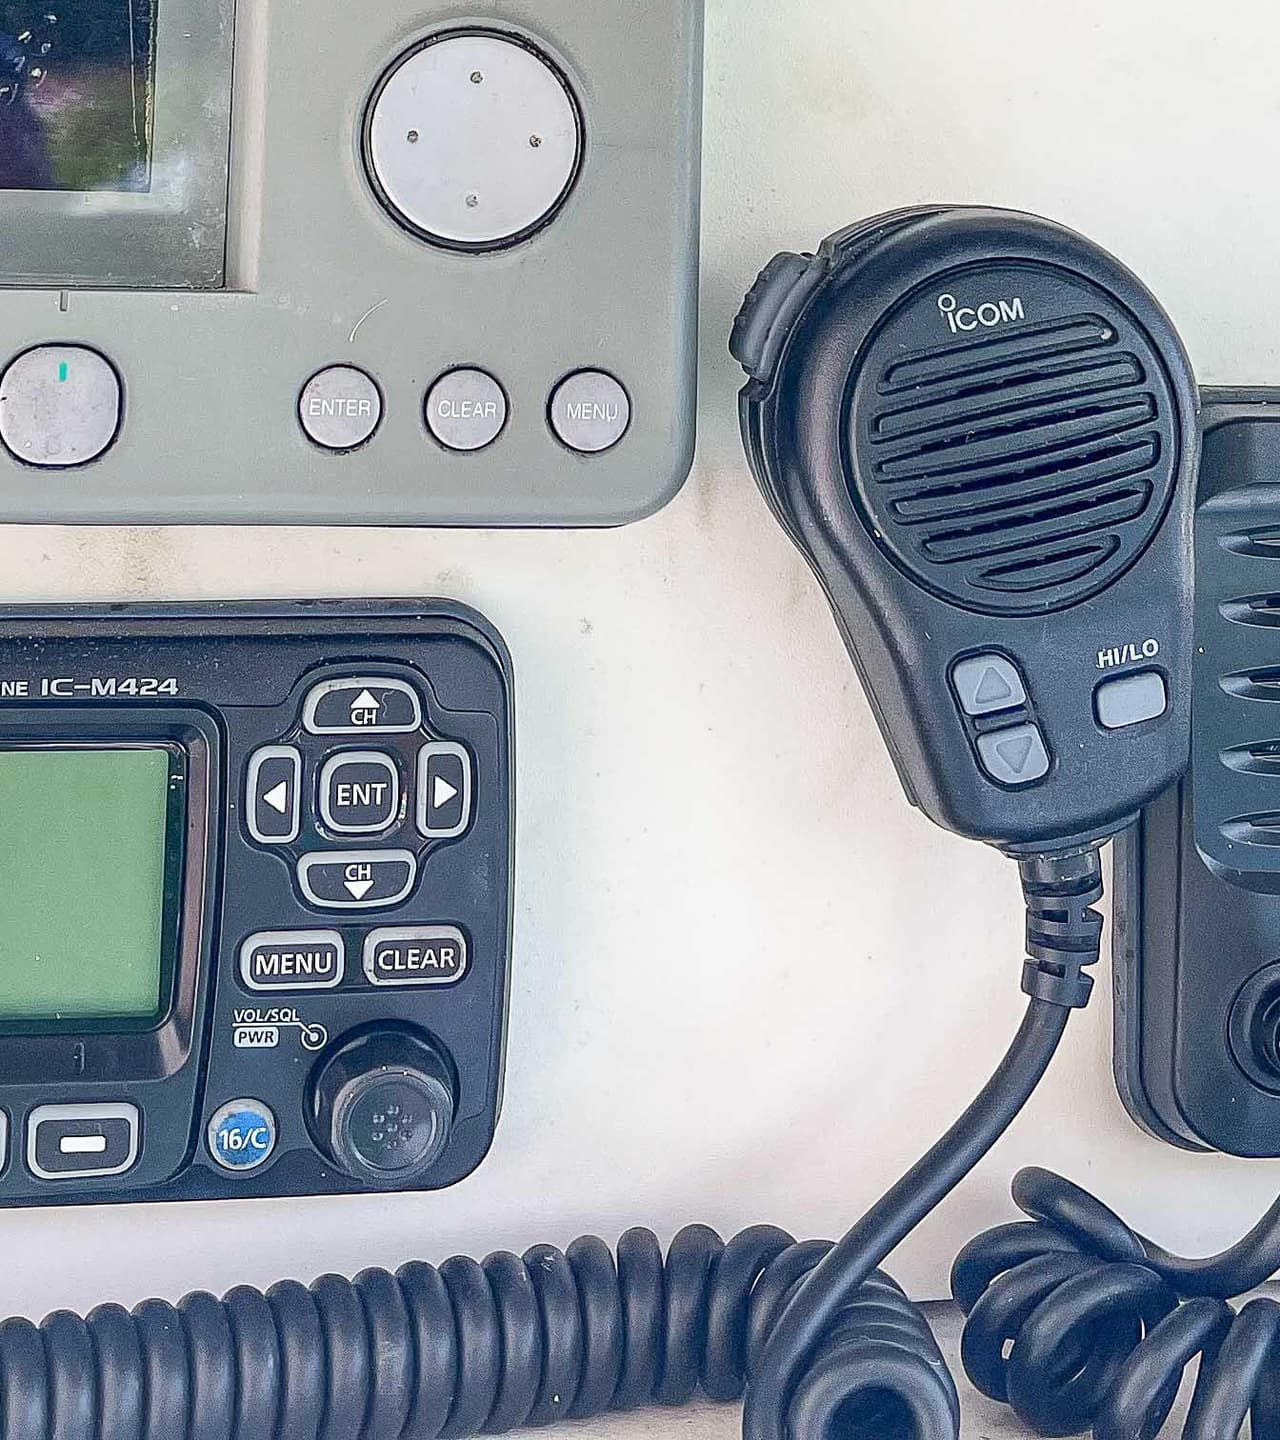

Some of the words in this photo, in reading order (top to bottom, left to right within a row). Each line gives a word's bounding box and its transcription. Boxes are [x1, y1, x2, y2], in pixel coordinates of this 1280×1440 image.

[309, 398, 371, 417] ENTER
[438, 399, 497, 418] CLEAR
[567, 402, 618, 421] MENU
[1096, 638, 1159, 669] HI/LO
[40, 677, 179, 698] IC-M424
[350, 709, 377, 725] CH
[336, 783, 387, 806] ENT
[344, 864, 372, 880] CH
[255, 953, 332, 976] MENU
[377, 947, 456, 971] CLEAR
[233, 1008, 301, 1023] VOL/SQL
[237, 1030, 275, 1044] PWR
[219, 1126, 267, 1151] 16/C
